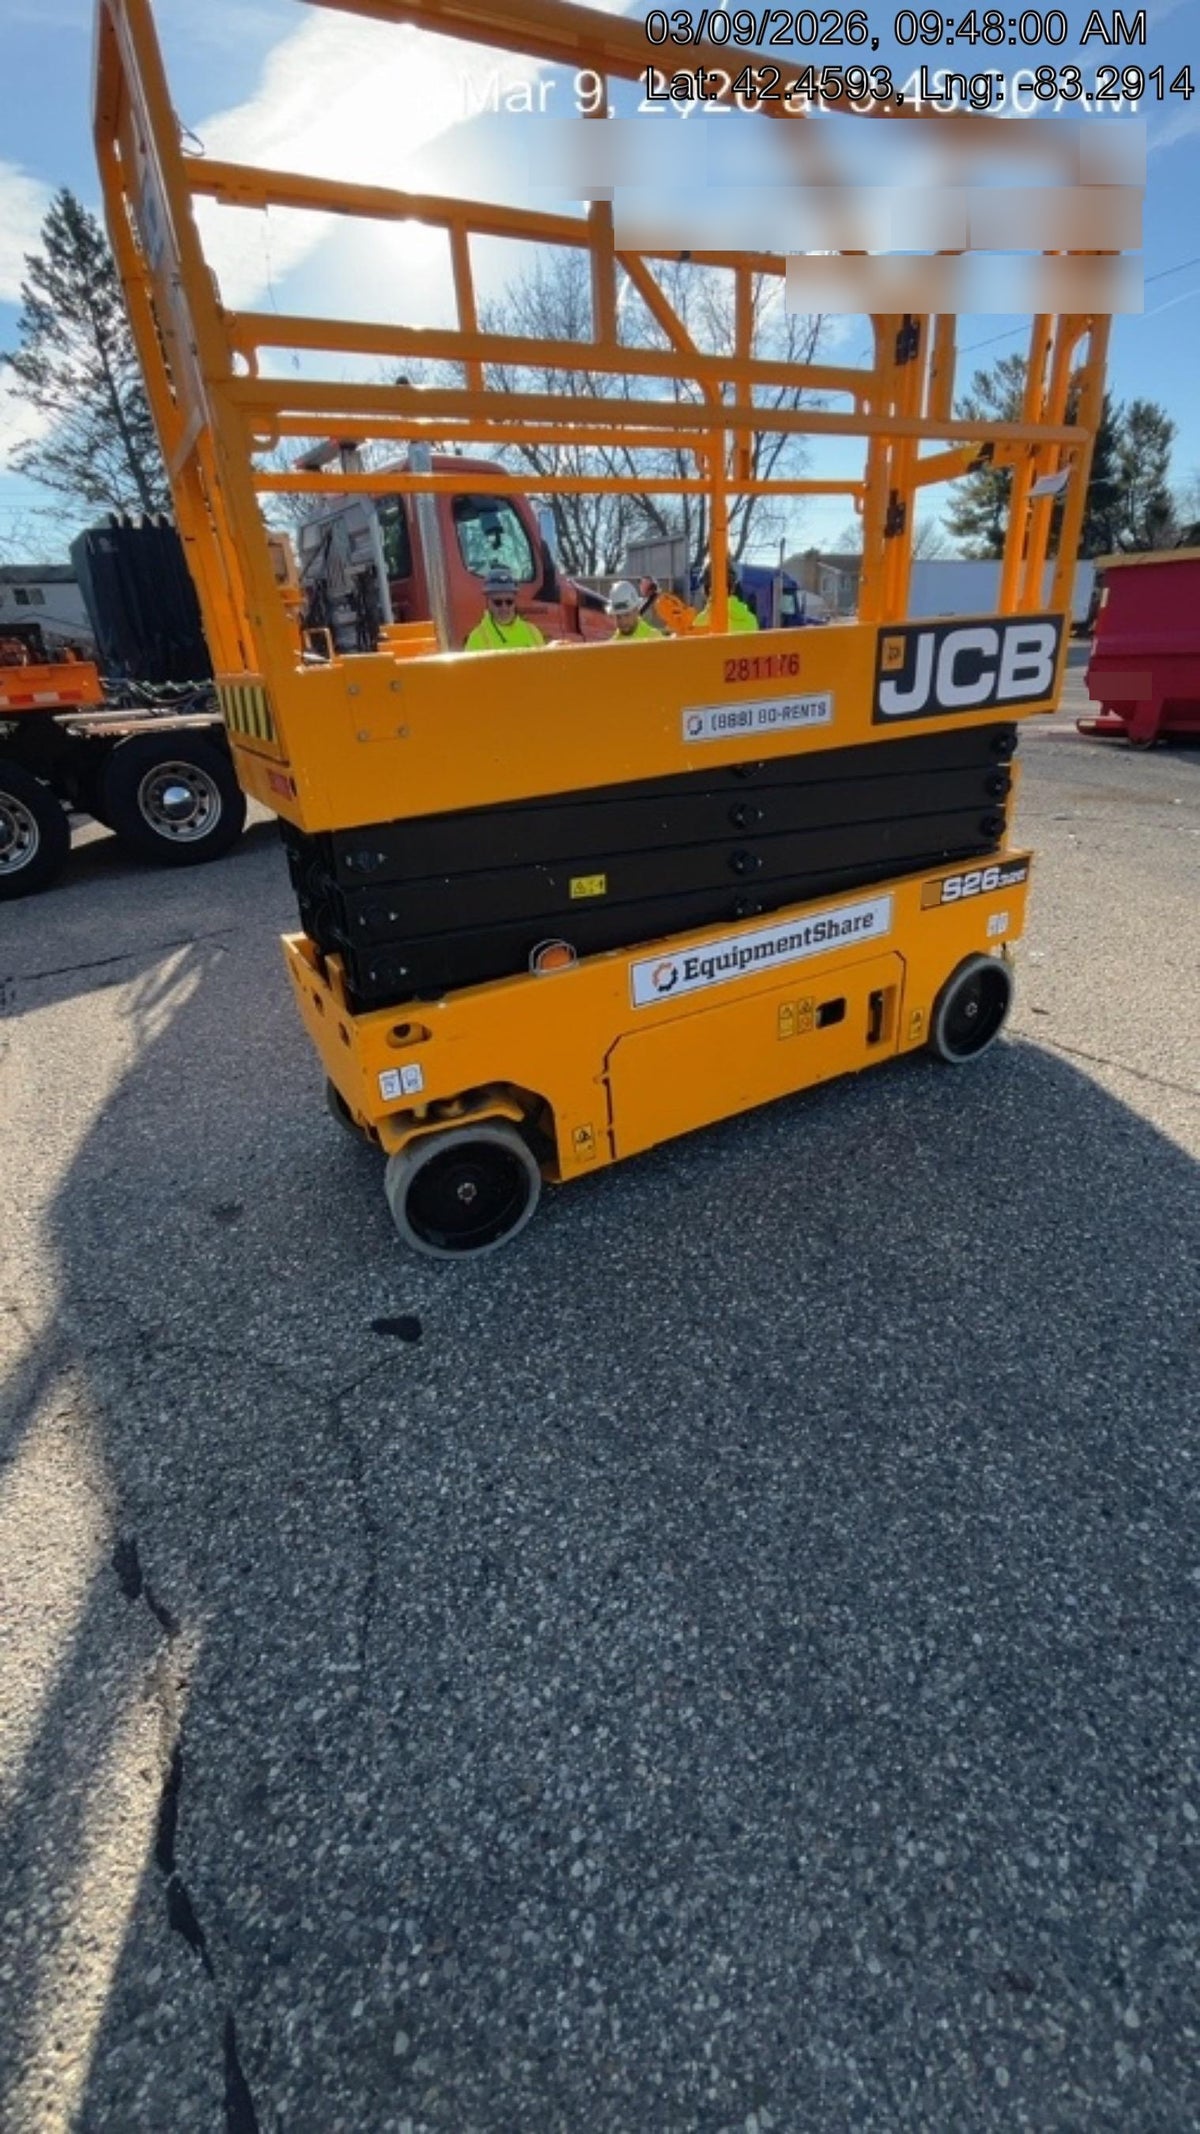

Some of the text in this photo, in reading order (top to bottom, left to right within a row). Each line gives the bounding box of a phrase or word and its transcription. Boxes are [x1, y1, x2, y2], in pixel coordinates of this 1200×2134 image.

[724, 653, 800, 683] 281176
[879, 623, 1057, 715] JCB
[682, 912, 875, 983] EquipmentShare
